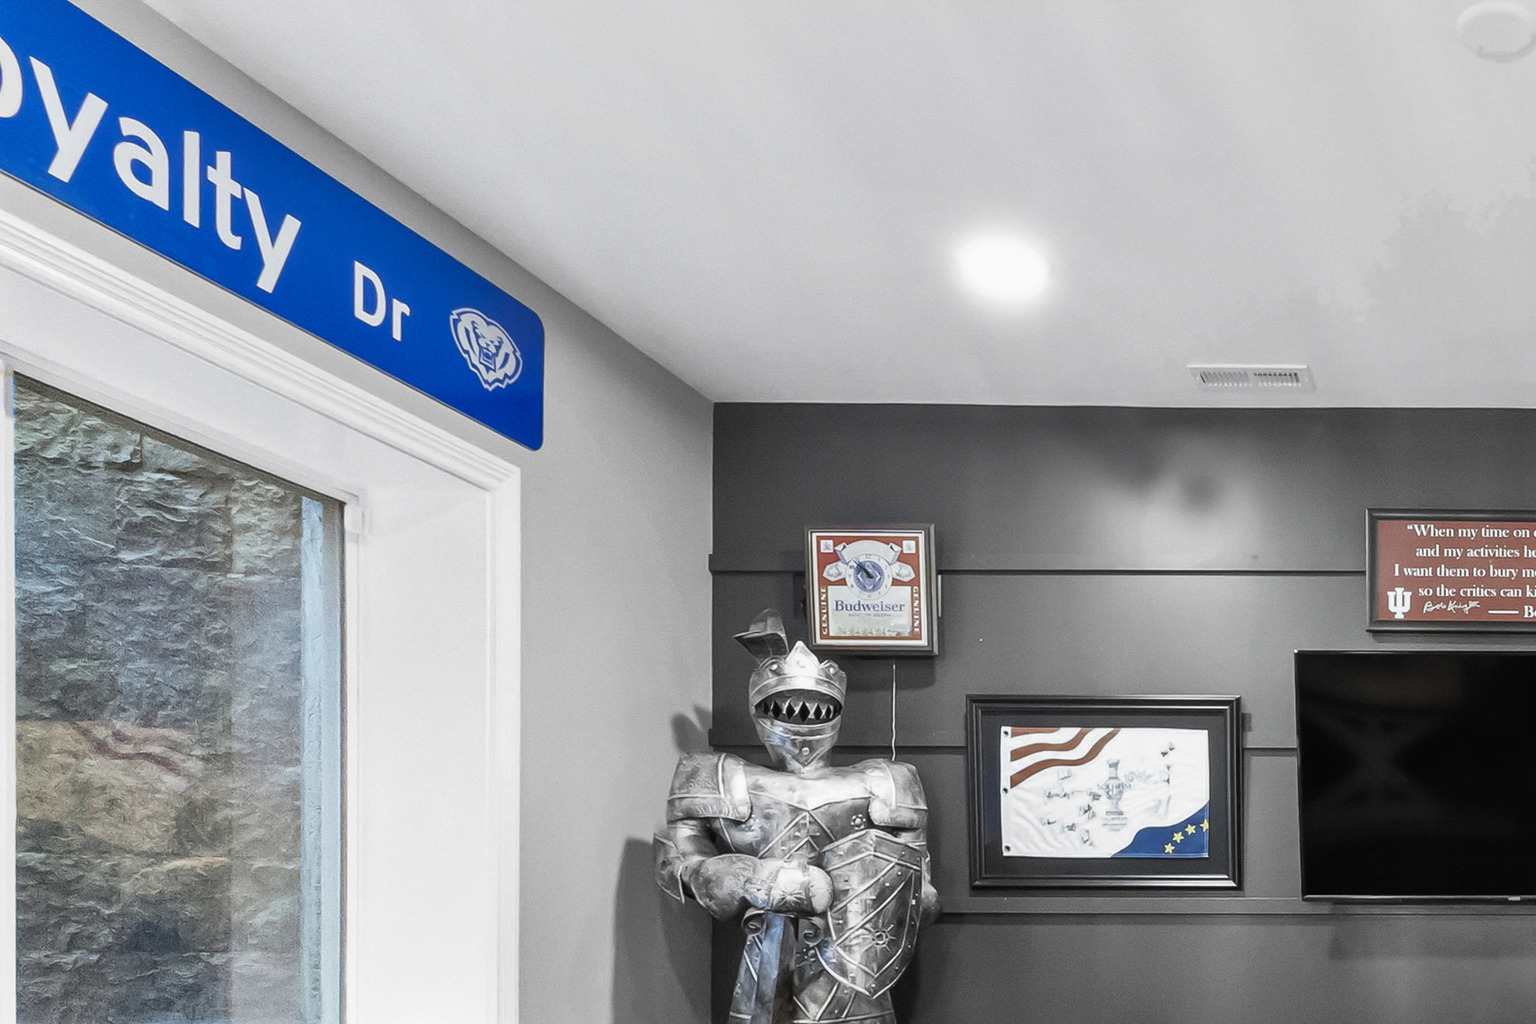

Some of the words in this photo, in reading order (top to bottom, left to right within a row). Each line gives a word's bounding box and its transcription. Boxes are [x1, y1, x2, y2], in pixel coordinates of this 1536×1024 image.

[353, 260, 411, 342] Dr
[1406, 524, 1455, 538] “When
[1458, 527, 1478, 540] my
[1481, 524, 1510, 538] time
[1512, 528, 1530, 538] on
[1415, 543, 1440, 557] and
[1443, 547, 1464, 560] my
[1466, 544, 1520, 558] activities
[1393, 563, 1400, 577] I
[1403, 565, 1433, 577] want
[1436, 564, 1470, 577] them
[1473, 566, 1487, 577] to
[1489, 564, 1519, 580] bury
[1418, 587, 1433, 597] so
[1436, 583, 1457, 597] the
[1459, 584, 1497, 597] critics
[1499, 588, 1522, 598] can
[834, 600, 905, 612] Budweiser
